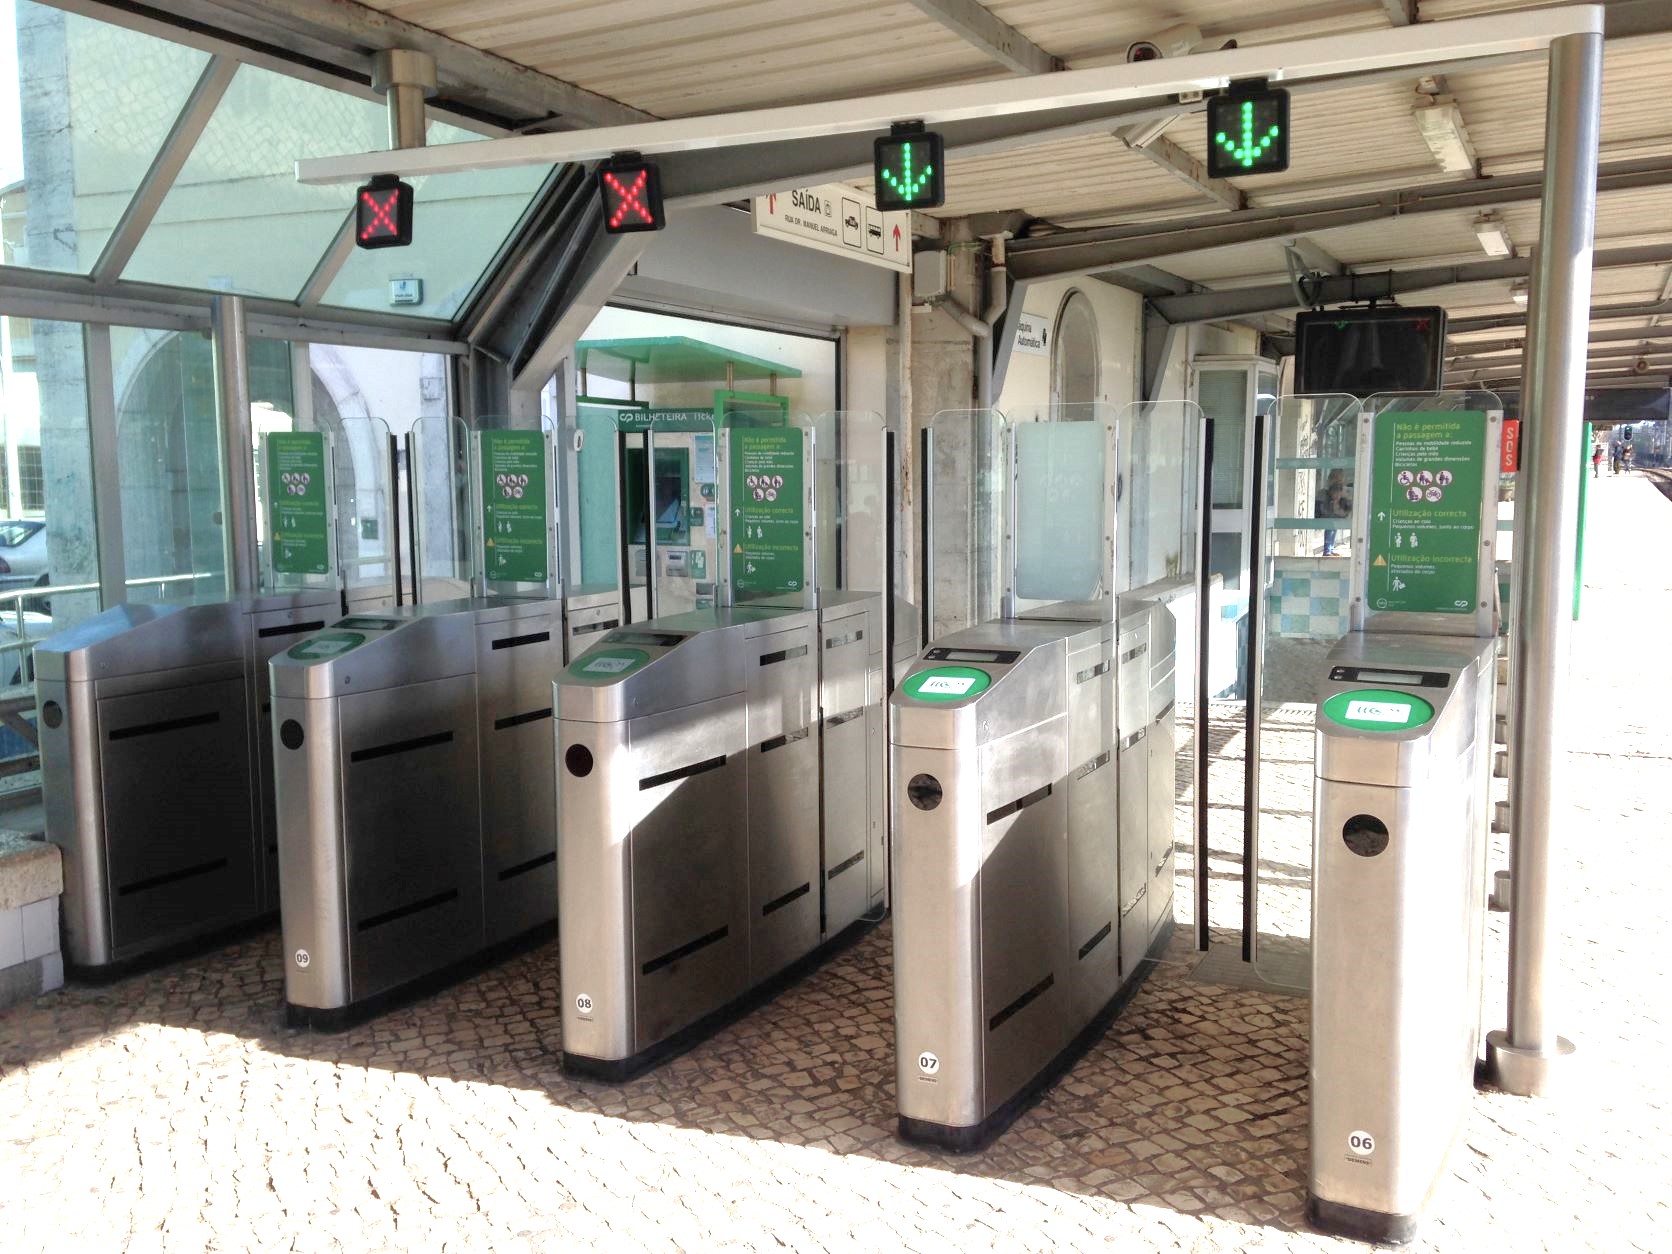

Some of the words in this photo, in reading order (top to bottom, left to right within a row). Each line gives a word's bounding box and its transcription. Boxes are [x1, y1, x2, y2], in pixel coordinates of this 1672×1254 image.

[791, 189, 821, 214] SAÍDA
[634, 412, 687, 421] BILHETEIRA
[1422, 423, 1460, 432] permitida
[1506, 427, 1514, 466] SOS
[1392, 510, 1432, 518] Utilização
[1391, 554, 1430, 562] Utilização
[1432, 555, 1472, 563] incorrecta
[296, 954, 308, 963] 09
[578, 998, 592, 1008] 08
[920, 1056, 937, 1068] 07
[1350, 1136, 1372, 1150] 06
